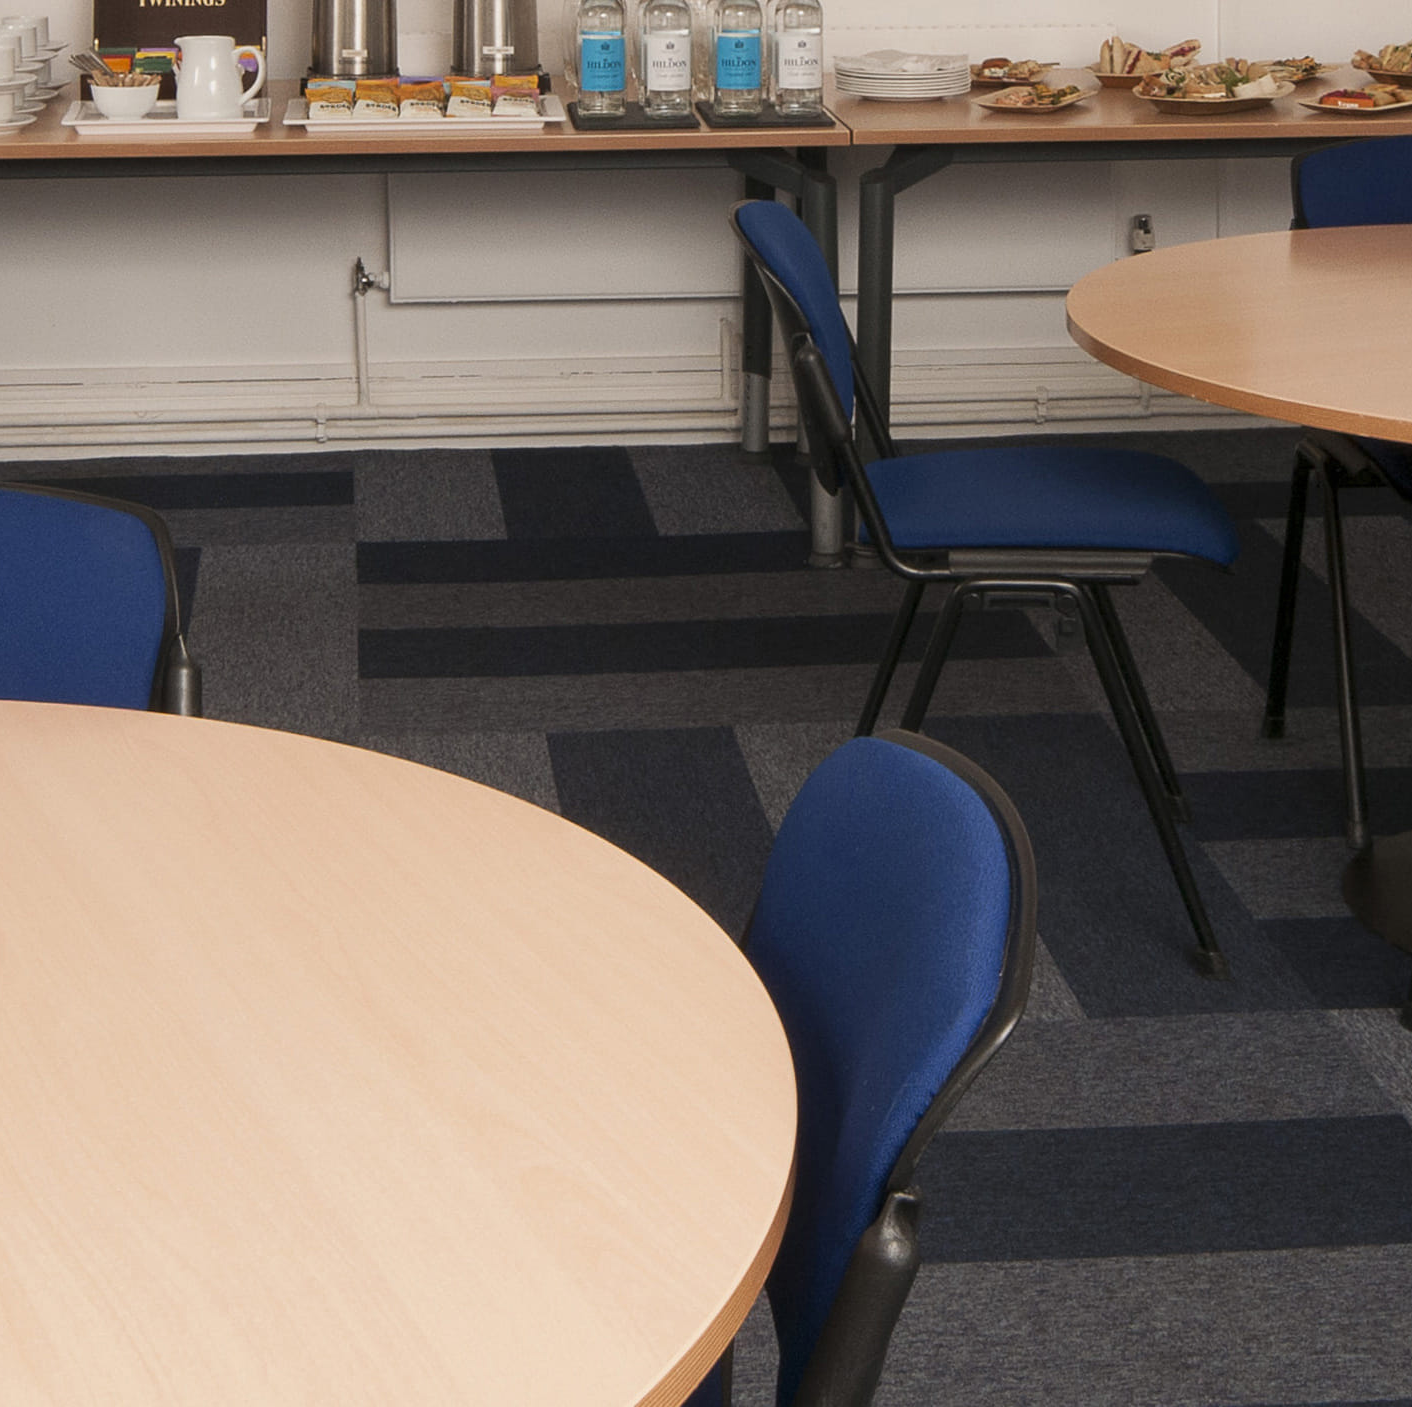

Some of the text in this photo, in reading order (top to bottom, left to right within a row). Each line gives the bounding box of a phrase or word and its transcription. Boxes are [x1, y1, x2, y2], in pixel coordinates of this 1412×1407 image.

[587, 60, 621, 69] HILDON
[652, 59, 687, 69] HILDON
[721, 58, 756, 68] HILDON
[784, 57, 818, 67] HILDON
